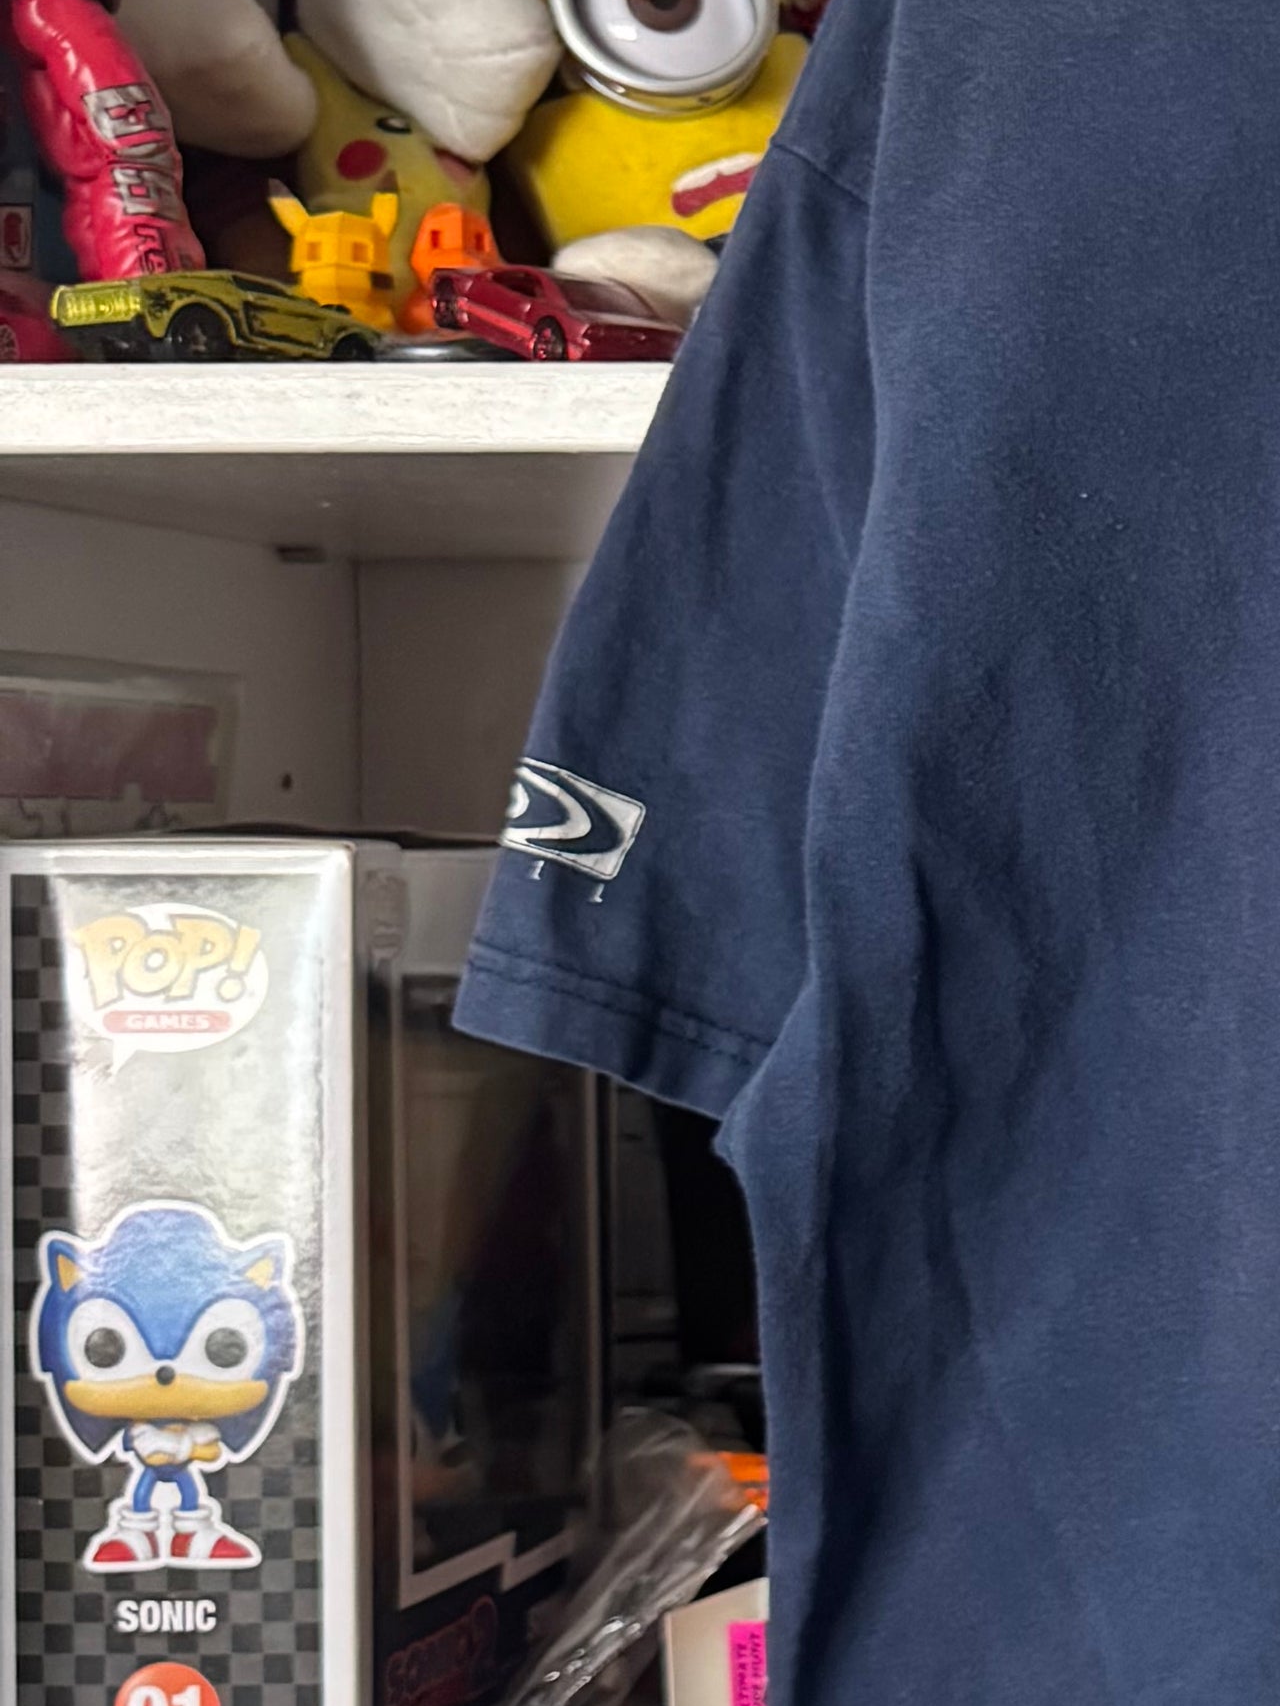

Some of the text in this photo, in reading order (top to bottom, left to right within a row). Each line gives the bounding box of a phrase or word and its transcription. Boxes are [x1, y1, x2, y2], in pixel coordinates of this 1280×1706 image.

[73, 911, 262, 1012] POP!
[125, 1013, 211, 1031] GAMES
[116, 1599, 217, 1633] SONIC
